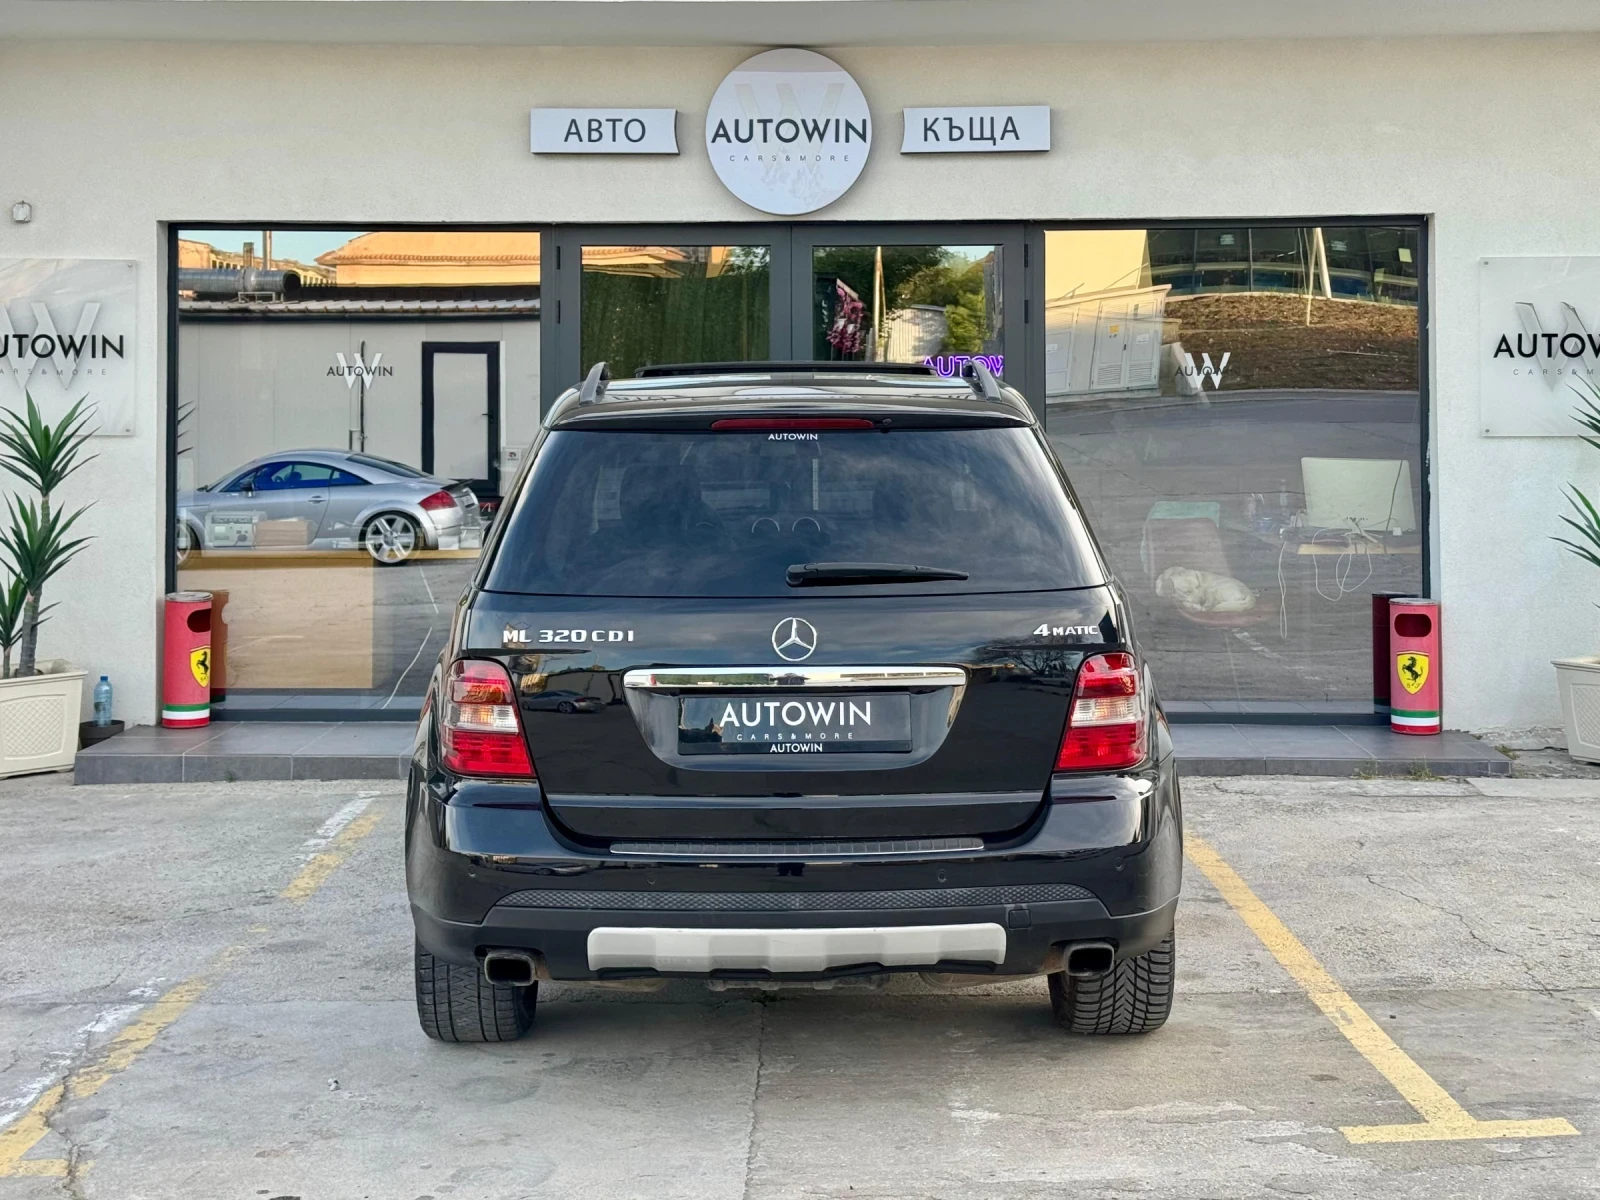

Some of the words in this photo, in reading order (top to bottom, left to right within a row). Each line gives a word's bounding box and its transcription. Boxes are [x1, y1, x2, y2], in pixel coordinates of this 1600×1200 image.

[563, 118, 646, 143] АВТО
[711, 118, 867, 144] AUTOWIN
[923, 116, 1020, 146] КЪЩА
[326, 366, 393, 377] AUTOWIN
[768, 433, 818, 441] AUTOWIN
[502, 629, 532, 643] ML
[719, 701, 872, 728] AUTOWIN
[769, 743, 823, 753] AUTOWIN
